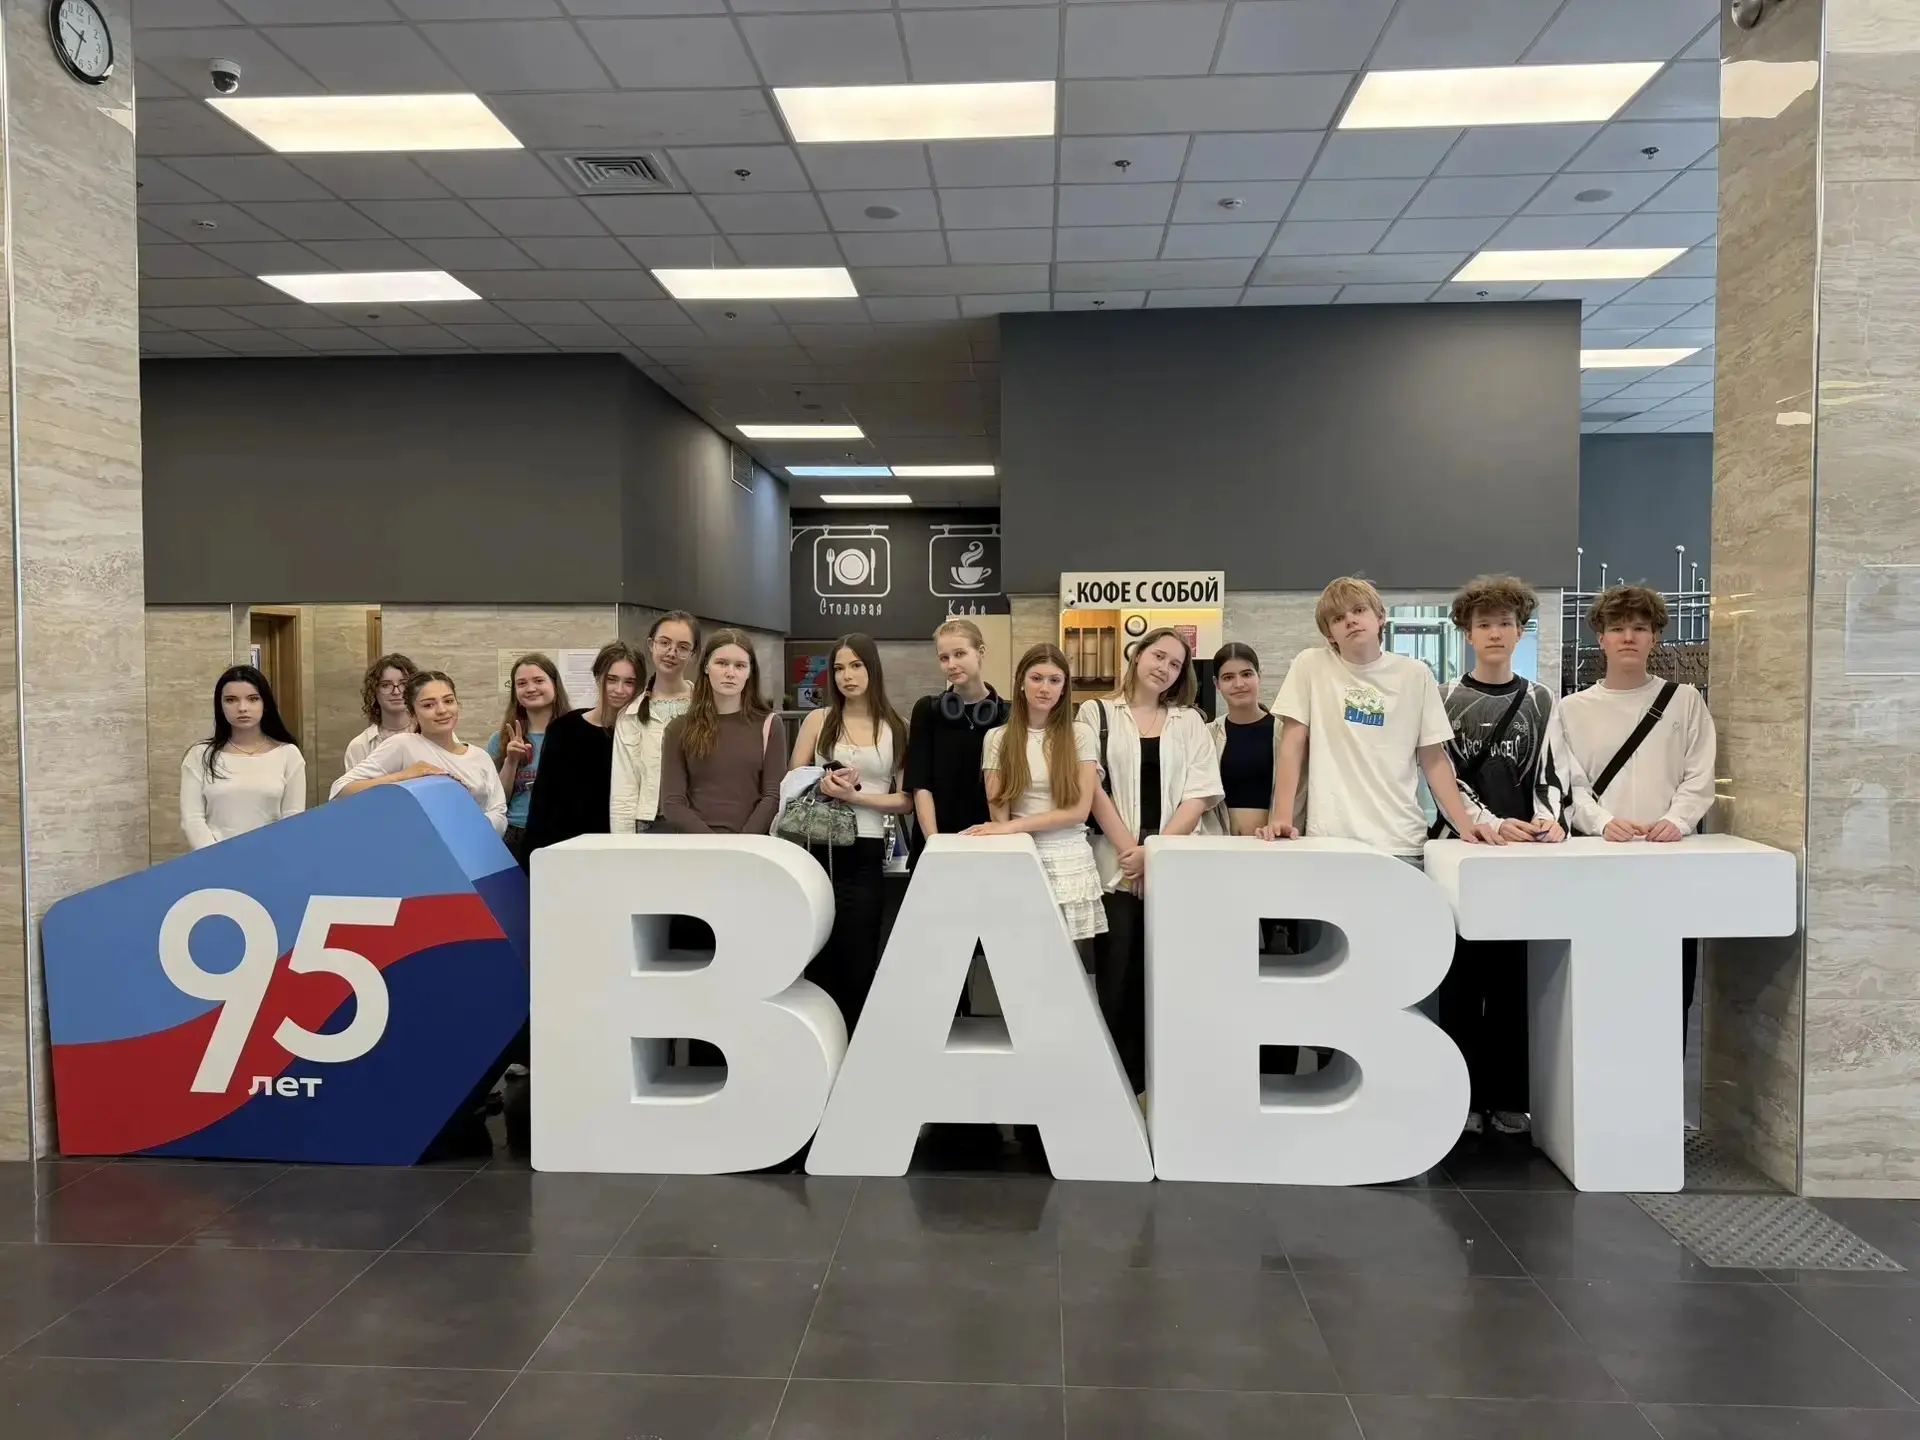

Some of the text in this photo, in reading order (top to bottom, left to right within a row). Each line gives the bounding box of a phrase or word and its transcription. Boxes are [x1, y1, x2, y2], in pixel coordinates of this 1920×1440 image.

[1077, 576, 1219, 604] КОФЕ С СОБОЙ
[819, 597, 883, 616] Столовая
[158, 888, 403, 1094] 95
[529, 833, 1799, 1192] ВАВТ
[247, 1075, 323, 1099] лет
